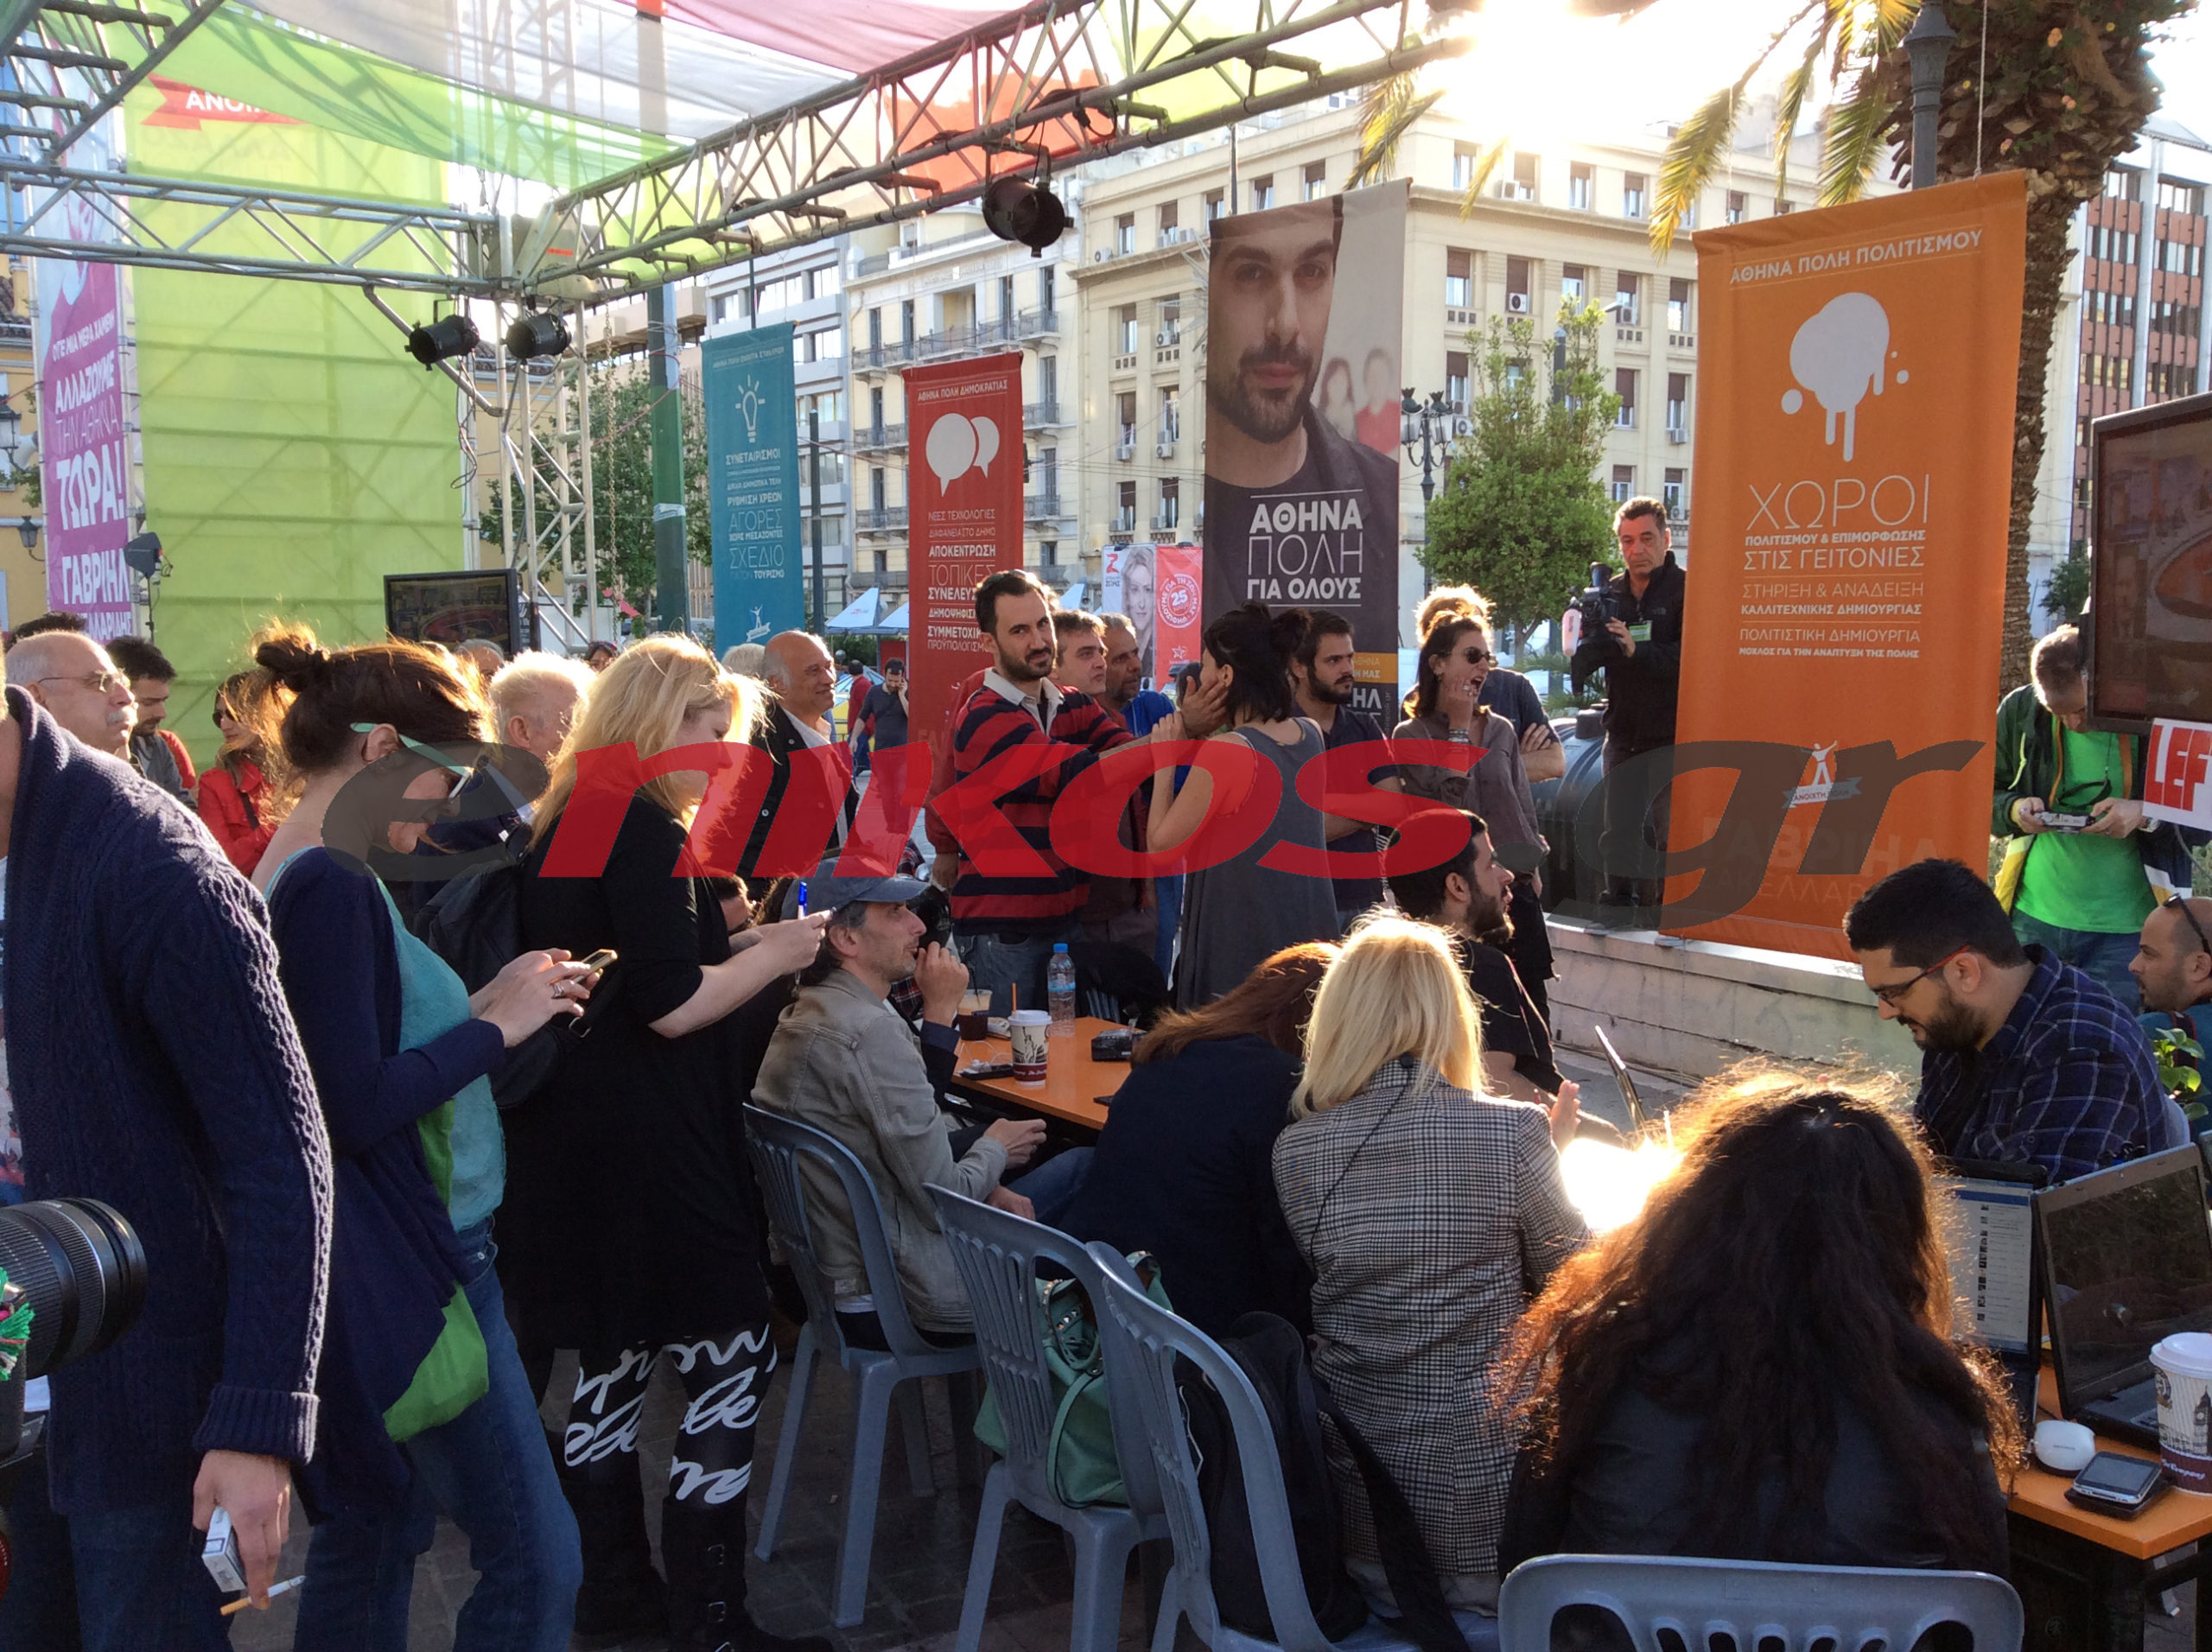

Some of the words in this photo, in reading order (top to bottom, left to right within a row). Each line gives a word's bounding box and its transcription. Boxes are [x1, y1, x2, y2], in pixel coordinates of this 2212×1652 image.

[1730, 261, 1792, 284] ΑΘΗΝΑ
[1798, 250, 1851, 274] ΠΟΛΗ
[1856, 229, 1983, 264] ΠΟΛΙΤΙΣΜΟΥ
[55, 349, 115, 414] ΑΛΛΑΖΟΥΜΕ
[918, 390, 939, 402] ΑΘΗΝΑ
[941, 385, 959, 397] ΠΟΛΗ
[960, 379, 1007, 396] ΔΗΜΟΚΡΑΤΙΑΣ
[57, 441, 124, 531] ΤΩΡΑ!
[1746, 473, 1929, 531] ΧΩΡΟΙ
[728, 507, 783, 532] ΑΓΟΡΕΣ
[928, 511, 945, 521] ΝΕΕΣ
[948, 509, 995, 520] ΤΕΧΝΟΛΟΓΙΕΣ
[1249, 498, 1363, 534] ΑΘΗΝΑ
[976, 527, 995, 537] ΔΗΜΟ
[1745, 534, 1818, 546] ΠΟΛΙΤΙΣΜΟΥ
[1821, 534, 1828, 543] &
[1832, 530, 1926, 543] ΕΠΙΜΟΡΦΩΣΗΣ
[729, 544, 785, 569] ΣΧΕΔΙΟ
[929, 544, 996, 557] ΑΠΟΚΕΝΤΡΩΣΗ
[1248, 532, 1363, 575] ΠΟΛΗ
[1744, 550, 1792, 570] ΣΤΙΣ
[1800, 546, 1925, 569] ΓΕΙΤΟΝΙΕΣ
[62, 548, 130, 604] ΓΑΒΡΙΗΛ
[1171, 589, 1188, 607] 25
[1247, 578, 1281, 600] ΓΙΑ
[1287, 577, 1361, 599] ΟΛΟΥΣ
[1743, 583, 1811, 599] ΣΤΗΡΙΞΗ
[1816, 584, 1827, 597] &
[1832, 581, 1923, 598] ΑΝΑΔΕΙΞΗ
[1741, 604, 1834, 615] ΚΑΛΛΙΤΕΧΝΙΚΗΣ
[1837, 604, 1922, 615] ΔΗΜΙΟΥΡΓΙΑΣ
[1740, 628, 1825, 641] ΠΟΛΙΤΙΣΤΙΚΗ
[1829, 629, 1920, 642] ΔΗΜΙΟΥΡΓΙΑ
[1739, 647, 1775, 656] ΜΟΧΛΟΣ
[1777, 647, 1791, 656] ΓΙΑ
[1793, 648, 1812, 657] ΤΗΝ
[1814, 648, 1863, 658] ΑΝΑΠΤΥΞΗ
[1866, 649, 1885, 658] ΤΗΣ
[1886, 649, 1919, 658] ΠΟΛΗΣ
[1362, 670, 1381, 678] ΜΑΣ
[2144, 724, 2212, 811] LEF
